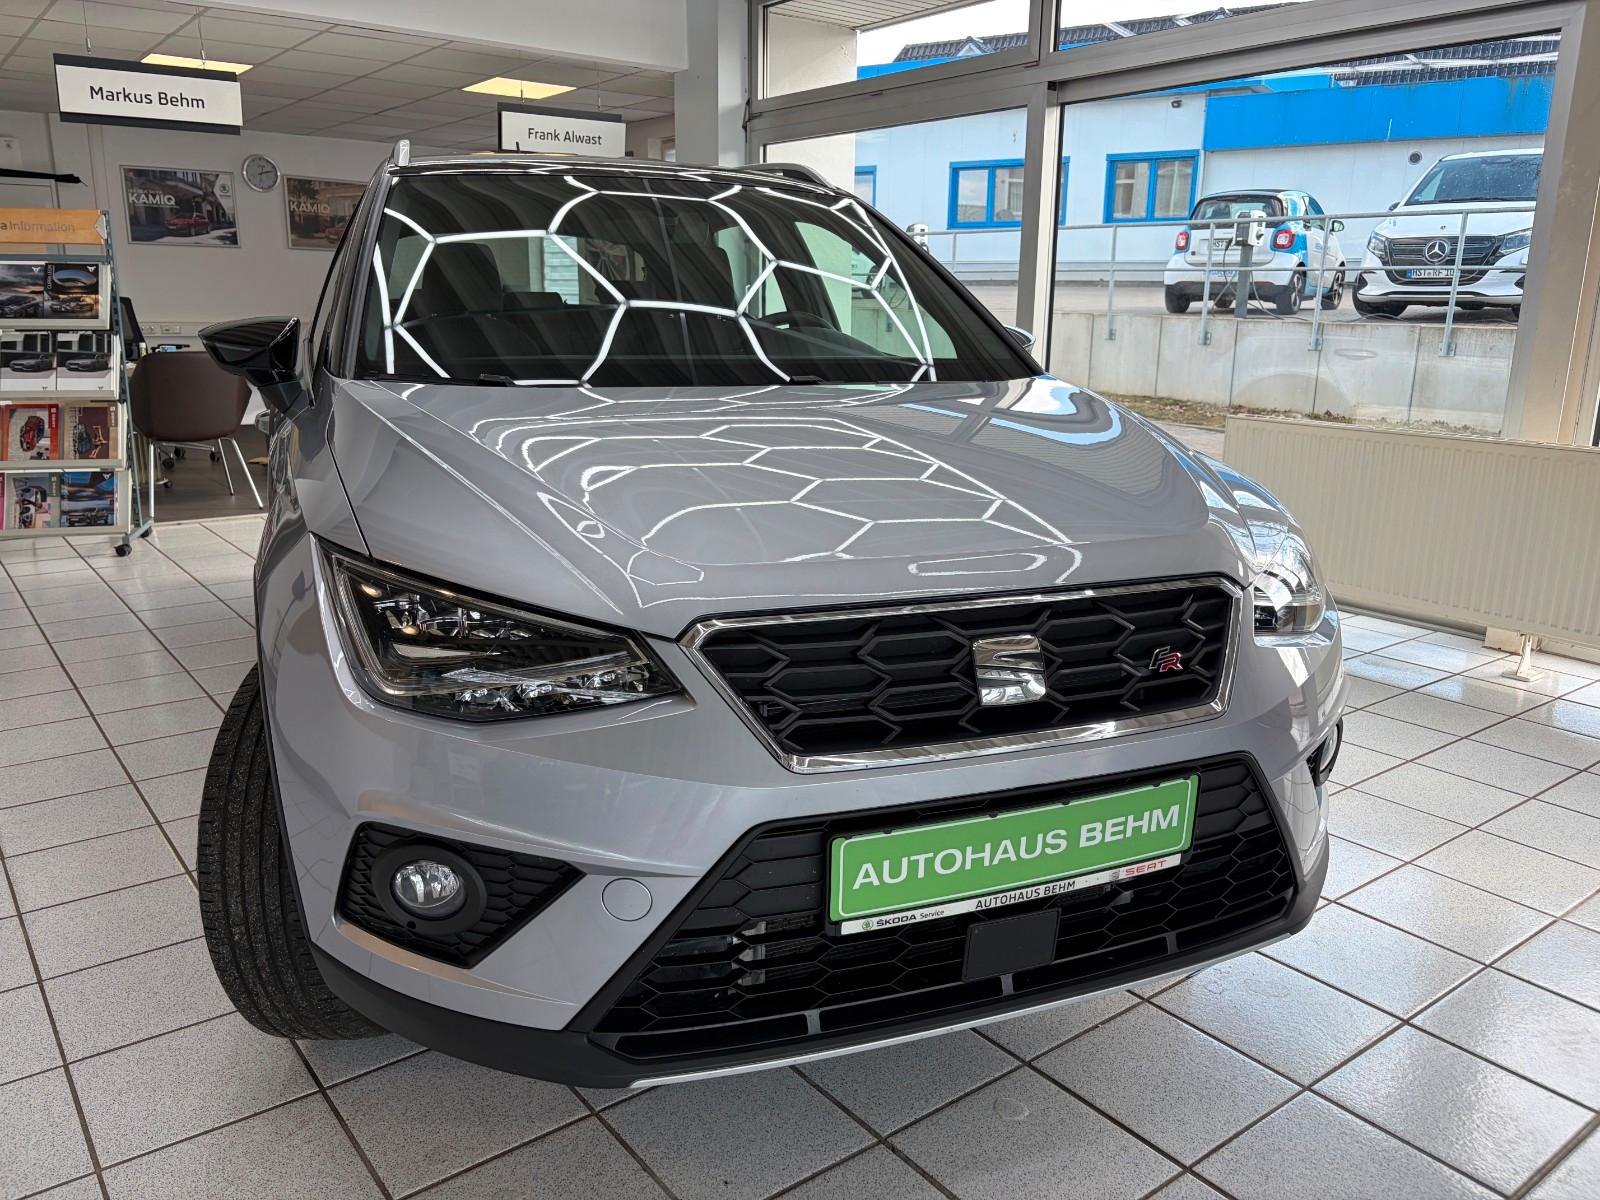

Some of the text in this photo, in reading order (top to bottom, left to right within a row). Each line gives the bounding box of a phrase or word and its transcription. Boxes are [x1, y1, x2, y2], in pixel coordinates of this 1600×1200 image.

[89, 85, 206, 109] Markus Behm
[528, 127, 603, 146] Frank Alwast
[127, 192, 176, 206] KAMIQ
[9, 220, 76, 232] Information
[852, 804, 1180, 890] AUTOHAUS BEHM
[1124, 859, 1168, 876] SEAT
[975, 880, 1076, 909] AUTOHAUS BEHM
[919, 909, 945, 919] Service
